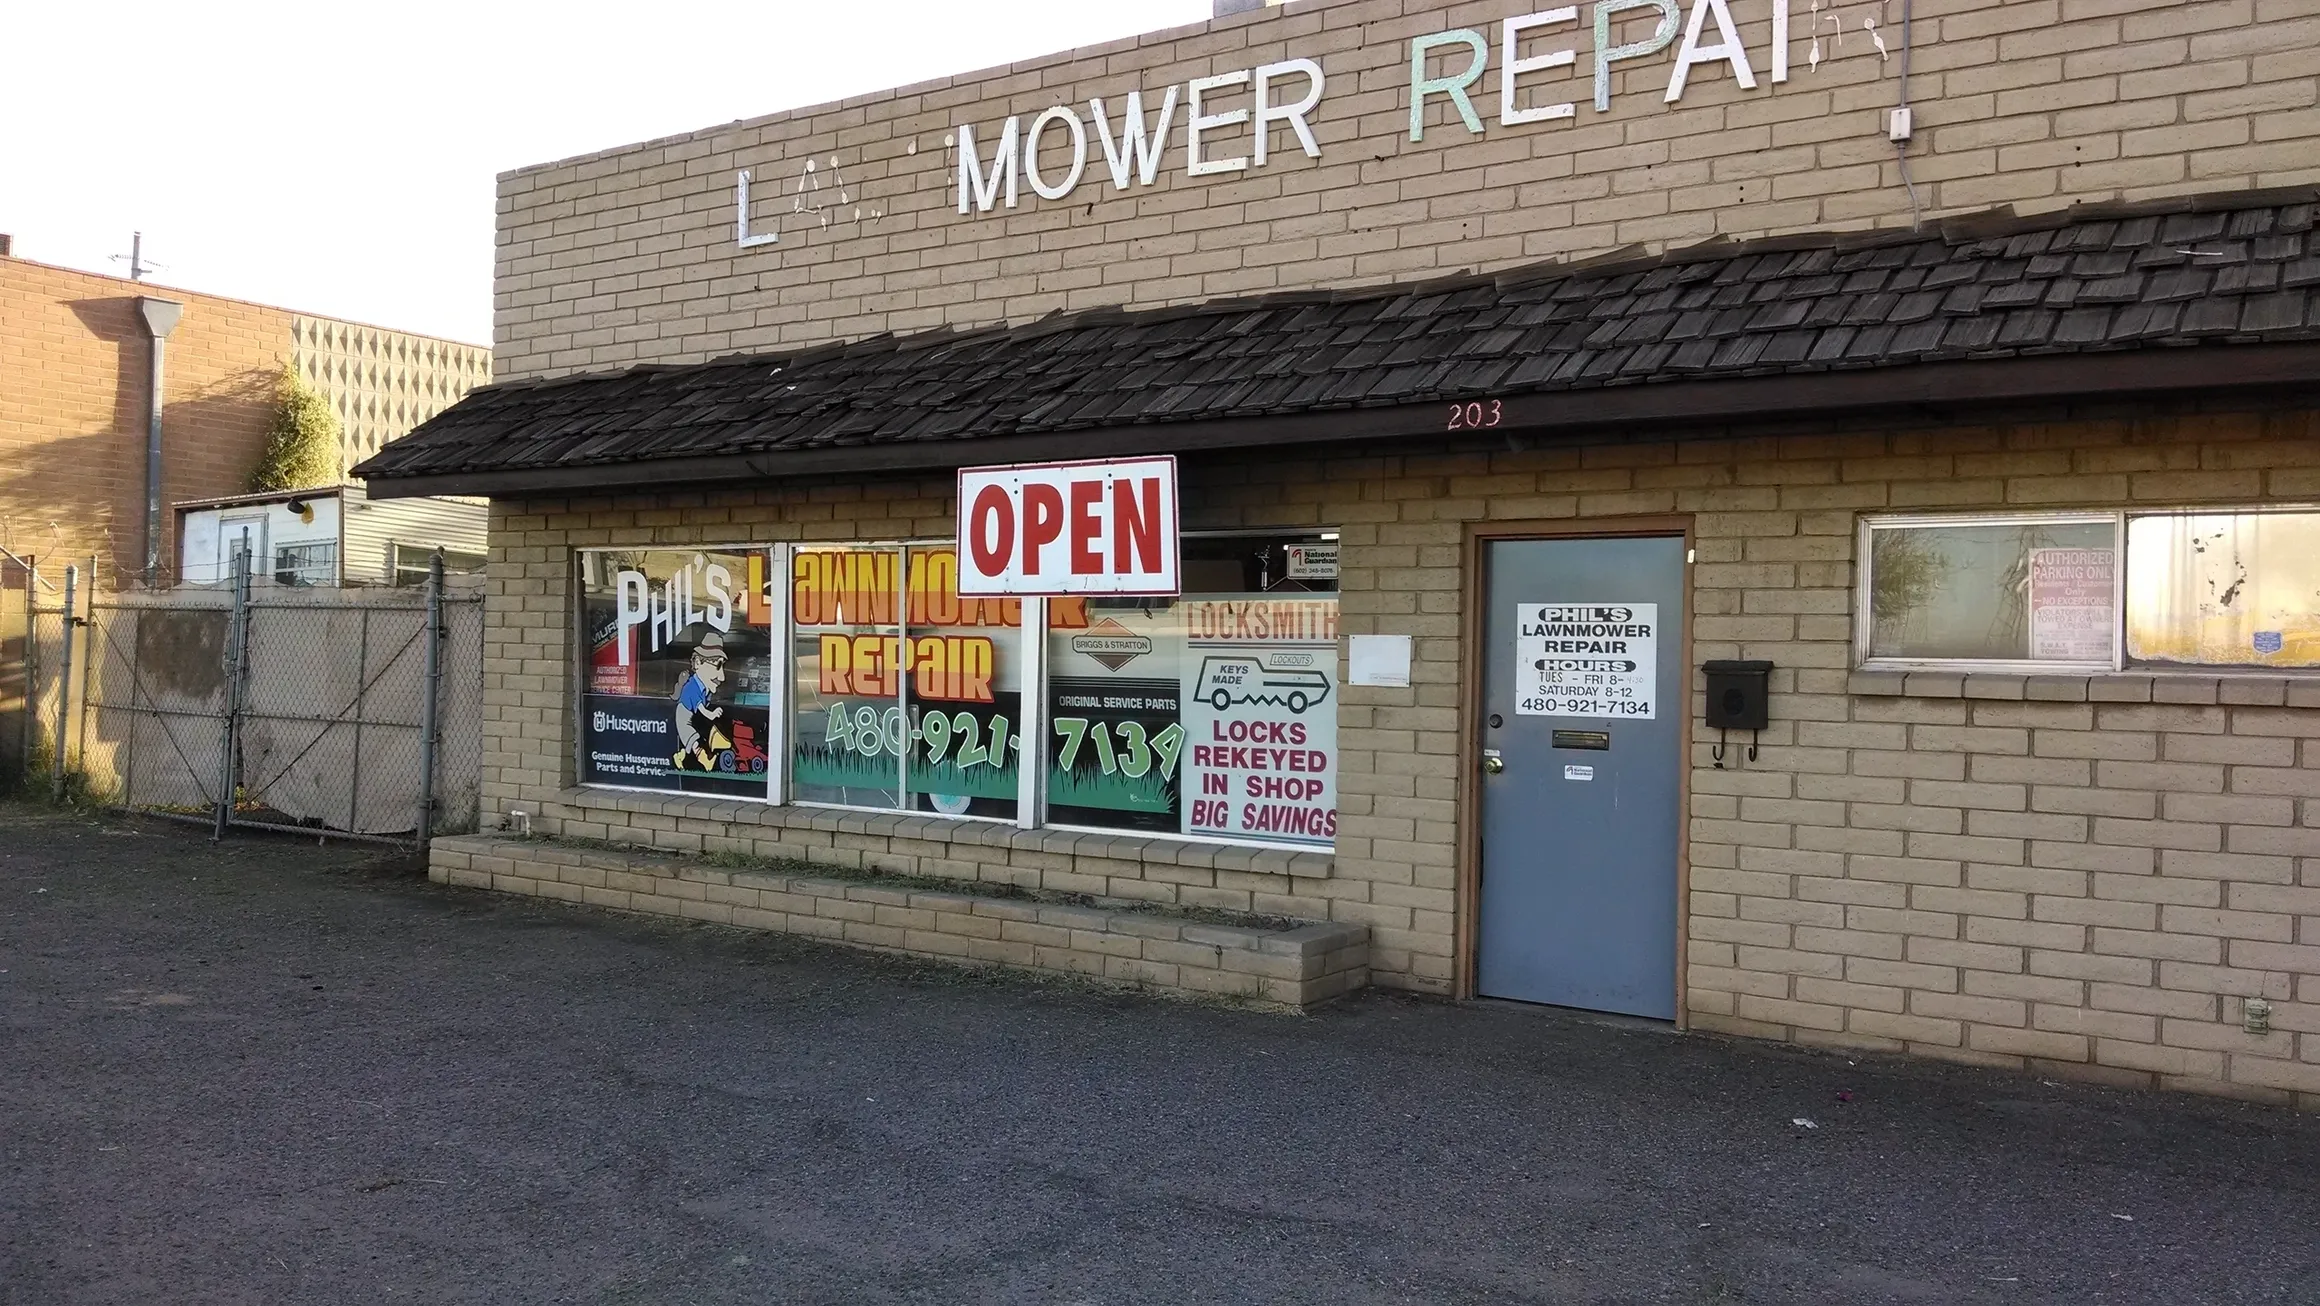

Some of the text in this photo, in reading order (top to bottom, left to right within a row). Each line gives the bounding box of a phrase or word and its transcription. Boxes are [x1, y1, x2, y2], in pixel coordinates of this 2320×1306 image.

[957, 58, 1326, 215] MOWER
[1447, 399, 1502, 431] 203
[970, 476, 1163, 578] OPEN
[1304, 550, 1338, 558] National
[1304, 557, 1338, 565] Guardian
[2036, 552, 2114, 566] AUTHORIZED
[2033, 566, 2084, 579] PARKING
[2064, 587, 2086, 597] Only
[2042, 596, 2108, 606] NO EXCEPTIONS
[616, 553, 732, 667] PHIL'S
[1544, 607, 1628, 622] PHIL'S
[1187, 601, 1338, 640] LOCKSMITH
[1522, 624, 1651, 637] LAWNMOWER
[1076, 640, 1148, 650] BRIGGS & STRATTON
[1544, 640, 1627, 653] REPAIR
[1273, 655, 1311, 665] LOCKOUTS
[1543, 659, 1628, 672] HOURS
[1219, 665, 1249, 675] KEYS
[1211, 675, 1243, 685] MADE
[1539, 671, 1563, 682] TUES
[1584, 674, 1603, 684] FRI
[1538, 685, 1633, 698] SATURDAY 8-12
[1058, 695, 1177, 711] ORIGINAL SERVICE PARTS
[1521, 698, 1650, 715] 480-921-7134
[606, 714, 667, 735] Husqvarna
[1213, 719, 1307, 745] LOCKS
[591, 750, 671, 767] Genuine Husqvarna
[1194, 745, 1327, 773] REKEYED
[596, 762, 667, 777] Parts and Service
[1203, 773, 1324, 801] IN SHOP
[1190, 799, 1229, 829] BIG
[1241, 802, 1337, 837] SAVINGS
